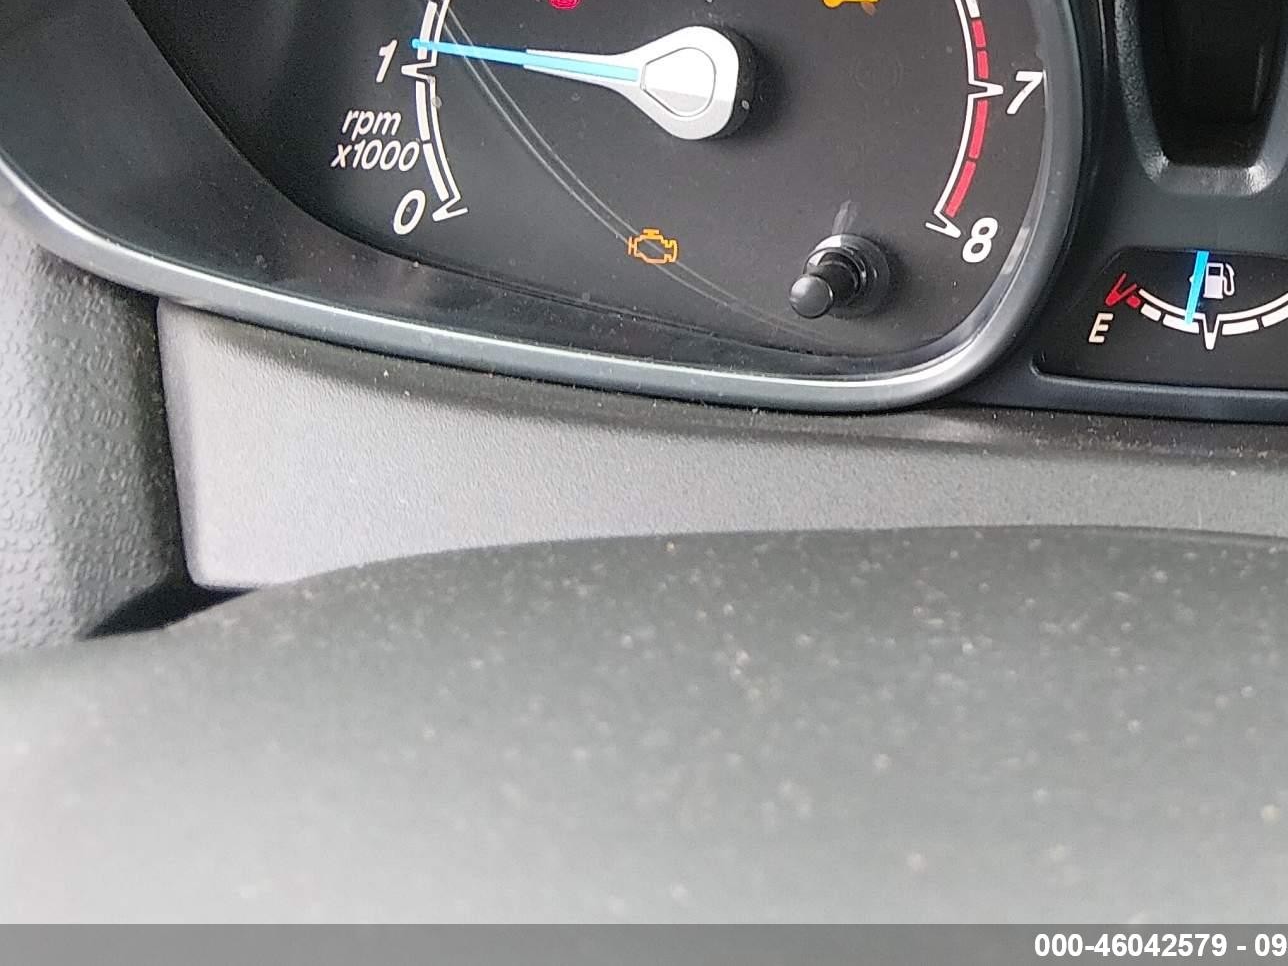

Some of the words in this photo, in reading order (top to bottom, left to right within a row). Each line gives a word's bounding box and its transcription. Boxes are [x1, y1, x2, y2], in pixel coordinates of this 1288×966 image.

[375, 41, 397, 83] 1
[1006, 70, 1044, 115] 7
[341, 110, 402, 141] rpm
[330, 139, 420, 171] x1000
[393, 189, 426, 235] 0
[962, 217, 999, 263] 8
[1088, 313, 1114, 343] E
